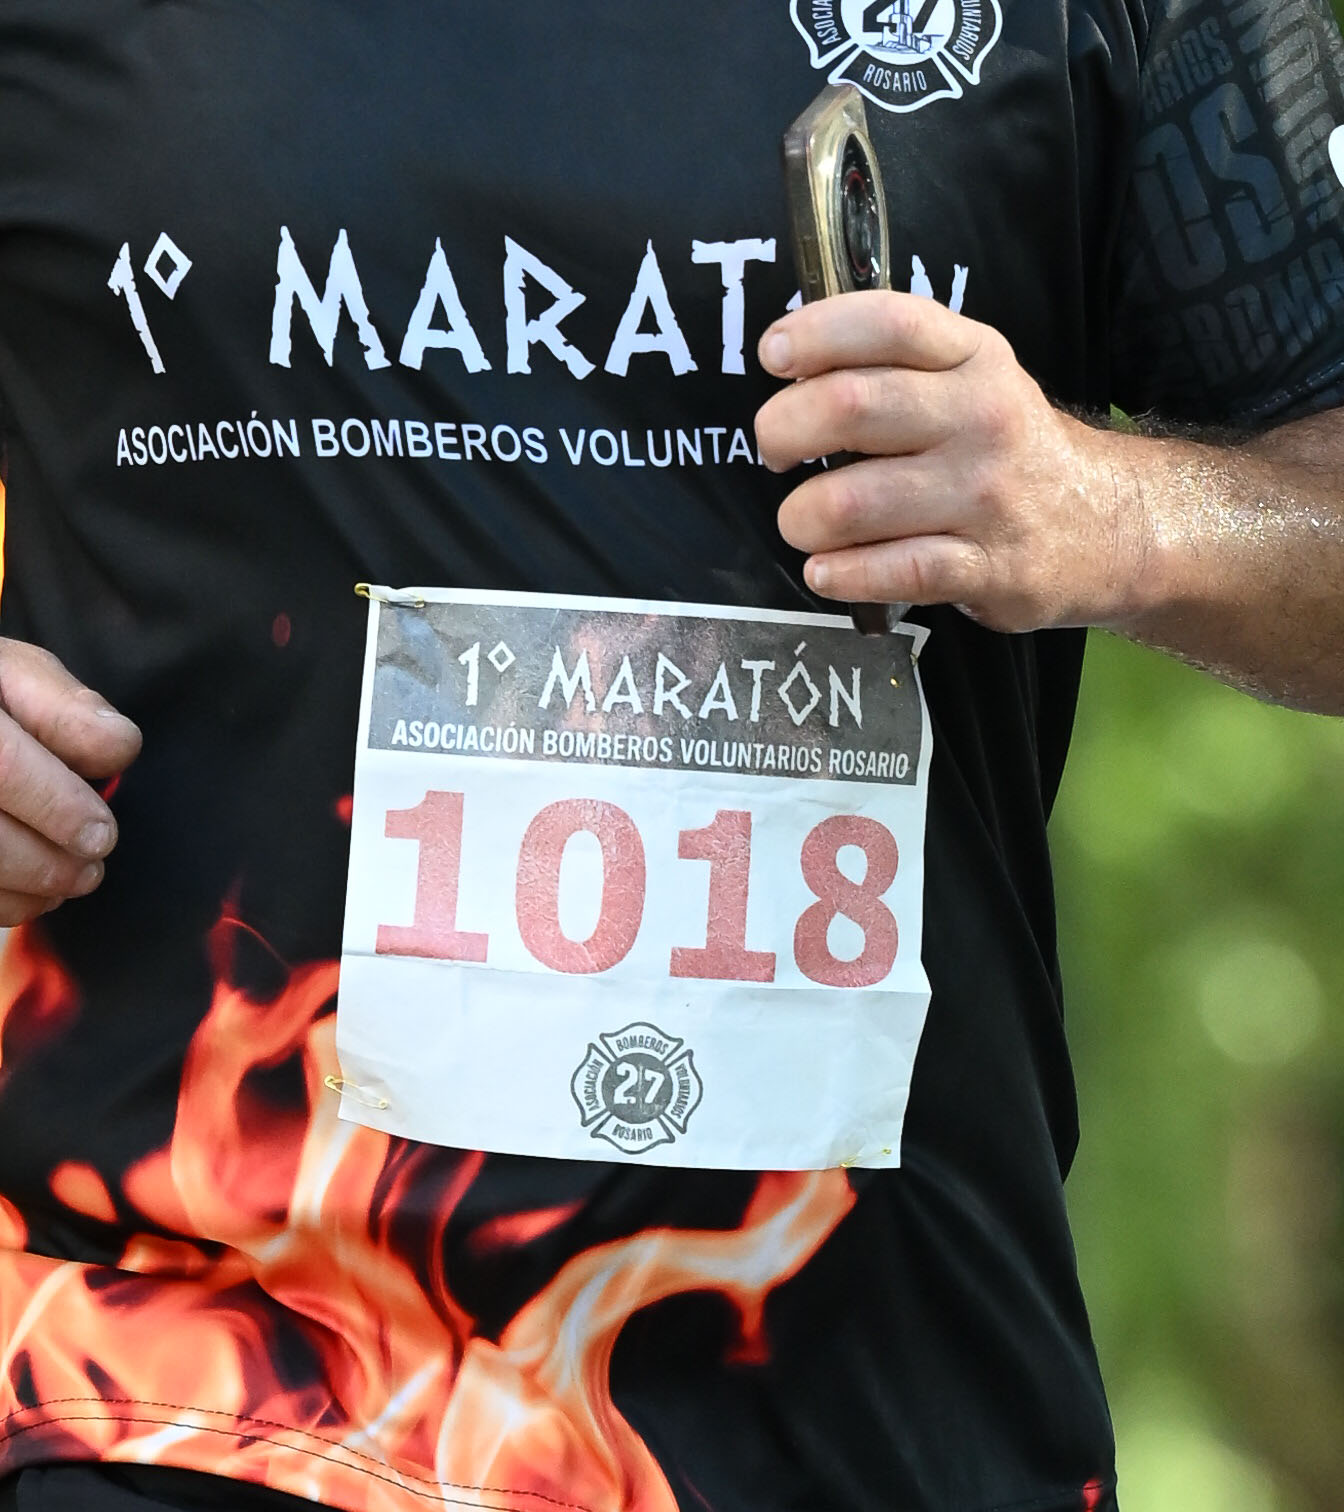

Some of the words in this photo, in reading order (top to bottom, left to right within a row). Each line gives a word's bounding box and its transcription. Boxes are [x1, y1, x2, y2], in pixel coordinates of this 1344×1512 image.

[863, 64, 928, 93] ROSARIO
[116, 410, 301, 467] ASOCIACIÓN
[311, 418, 549, 464] BOMBEROS
[538, 640, 863, 730] MARATÓN
[391, 718, 535, 755] ASOCIACIÓN
[542, 729, 674, 763] BOMBEROS
[679, 738, 823, 773] VOLUNTARIOS
[828, 748, 910, 780] ROSARIO
[375, 789, 900, 988] 1018
[615, 1035, 669, 1056] BOMBEROS
[613, 1061, 666, 1105] 27
